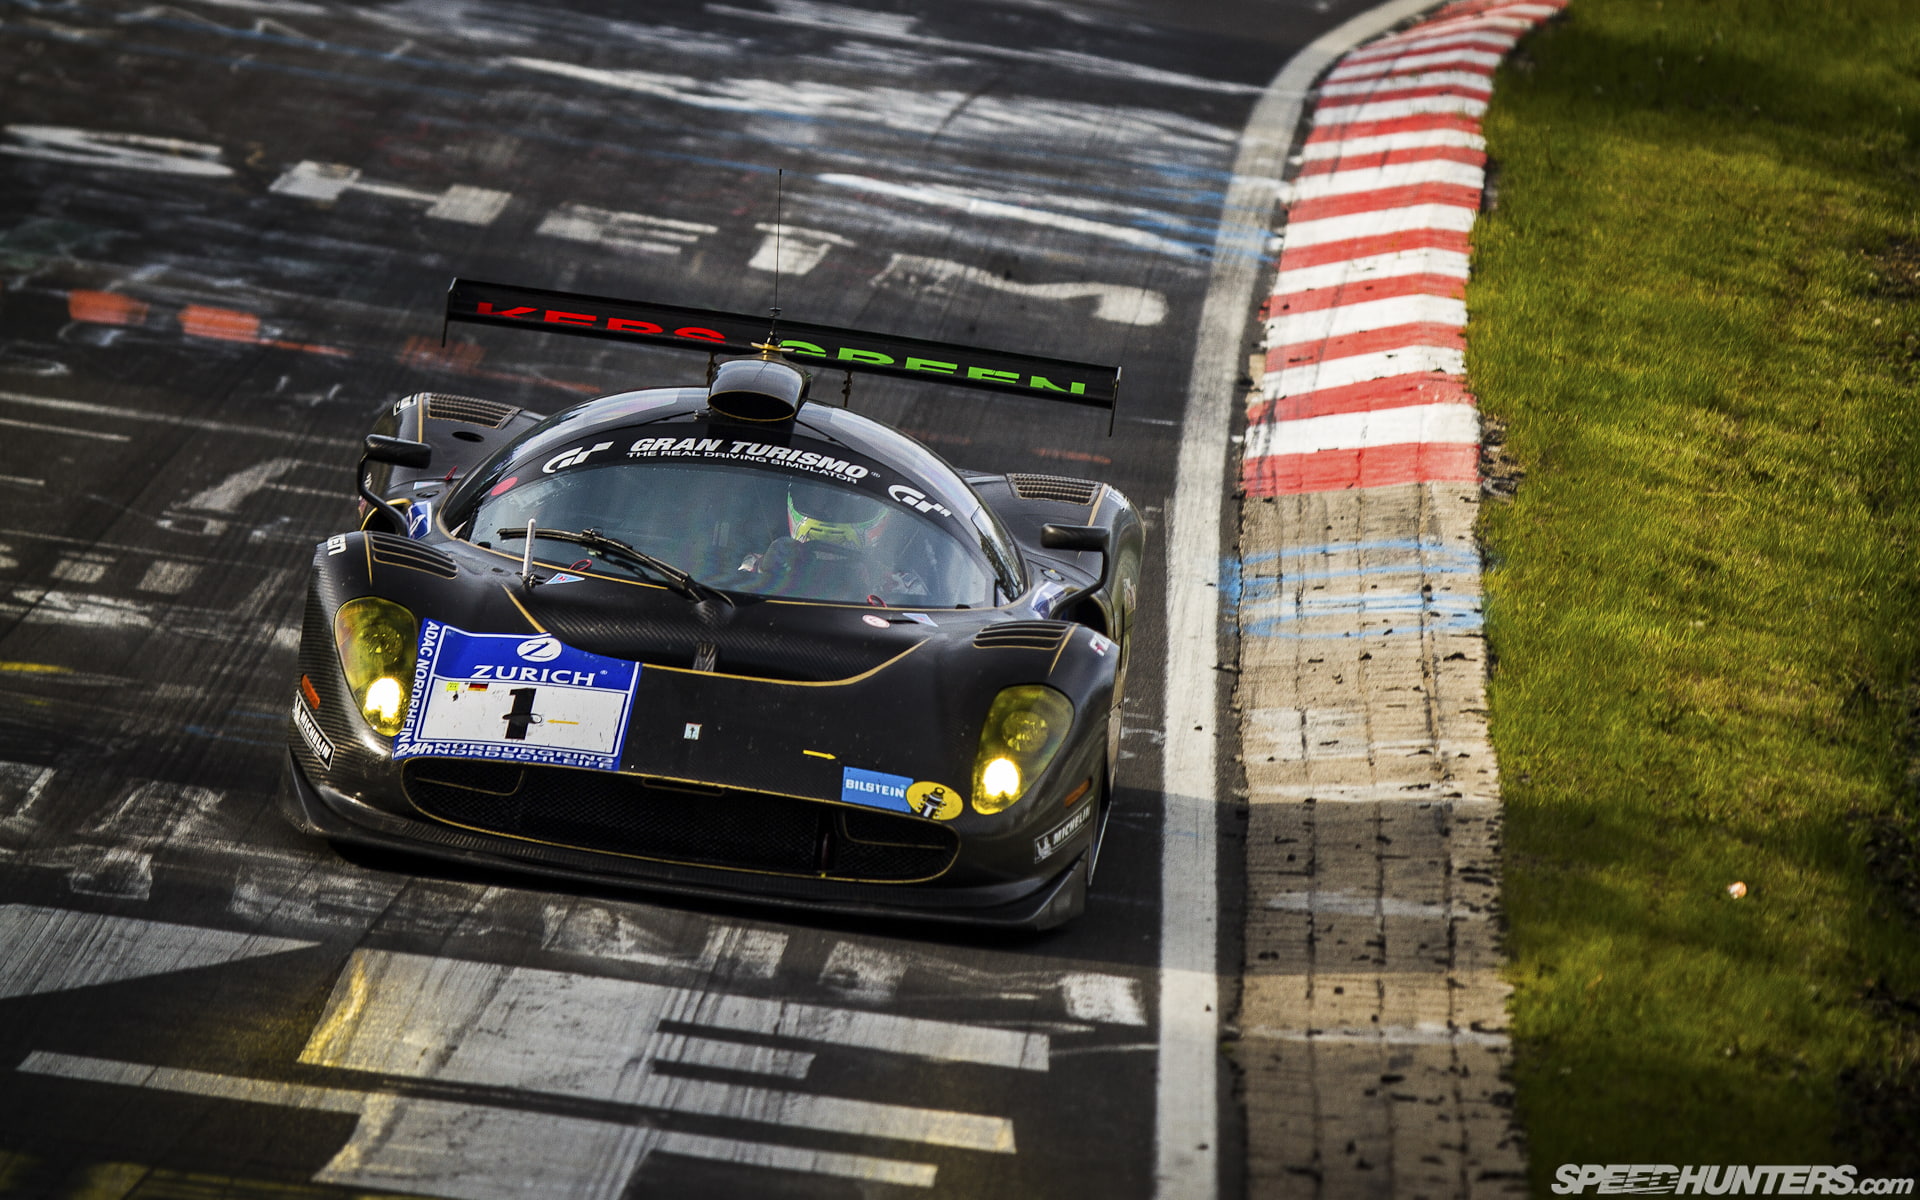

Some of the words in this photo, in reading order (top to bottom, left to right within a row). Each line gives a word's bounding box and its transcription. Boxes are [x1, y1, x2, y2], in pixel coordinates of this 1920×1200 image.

[630, 437, 724, 452] GRAN
[731, 441, 869, 479] TURISMO
[704, 451, 767, 463] DRIVING
[770, 458, 857, 485] SIMULATOR
[420, 620, 440, 657] ADAC
[470, 665, 595, 686] ZURICH
[398, 658, 429, 743] NORDRHEIN
[505, 688, 537, 740] 1
[300, 710, 332, 759] MICHELIN
[396, 743, 433, 755] 24h
[845, 779, 905, 798] BILSTEIN
[1052, 806, 1091, 846] MICHELIN
